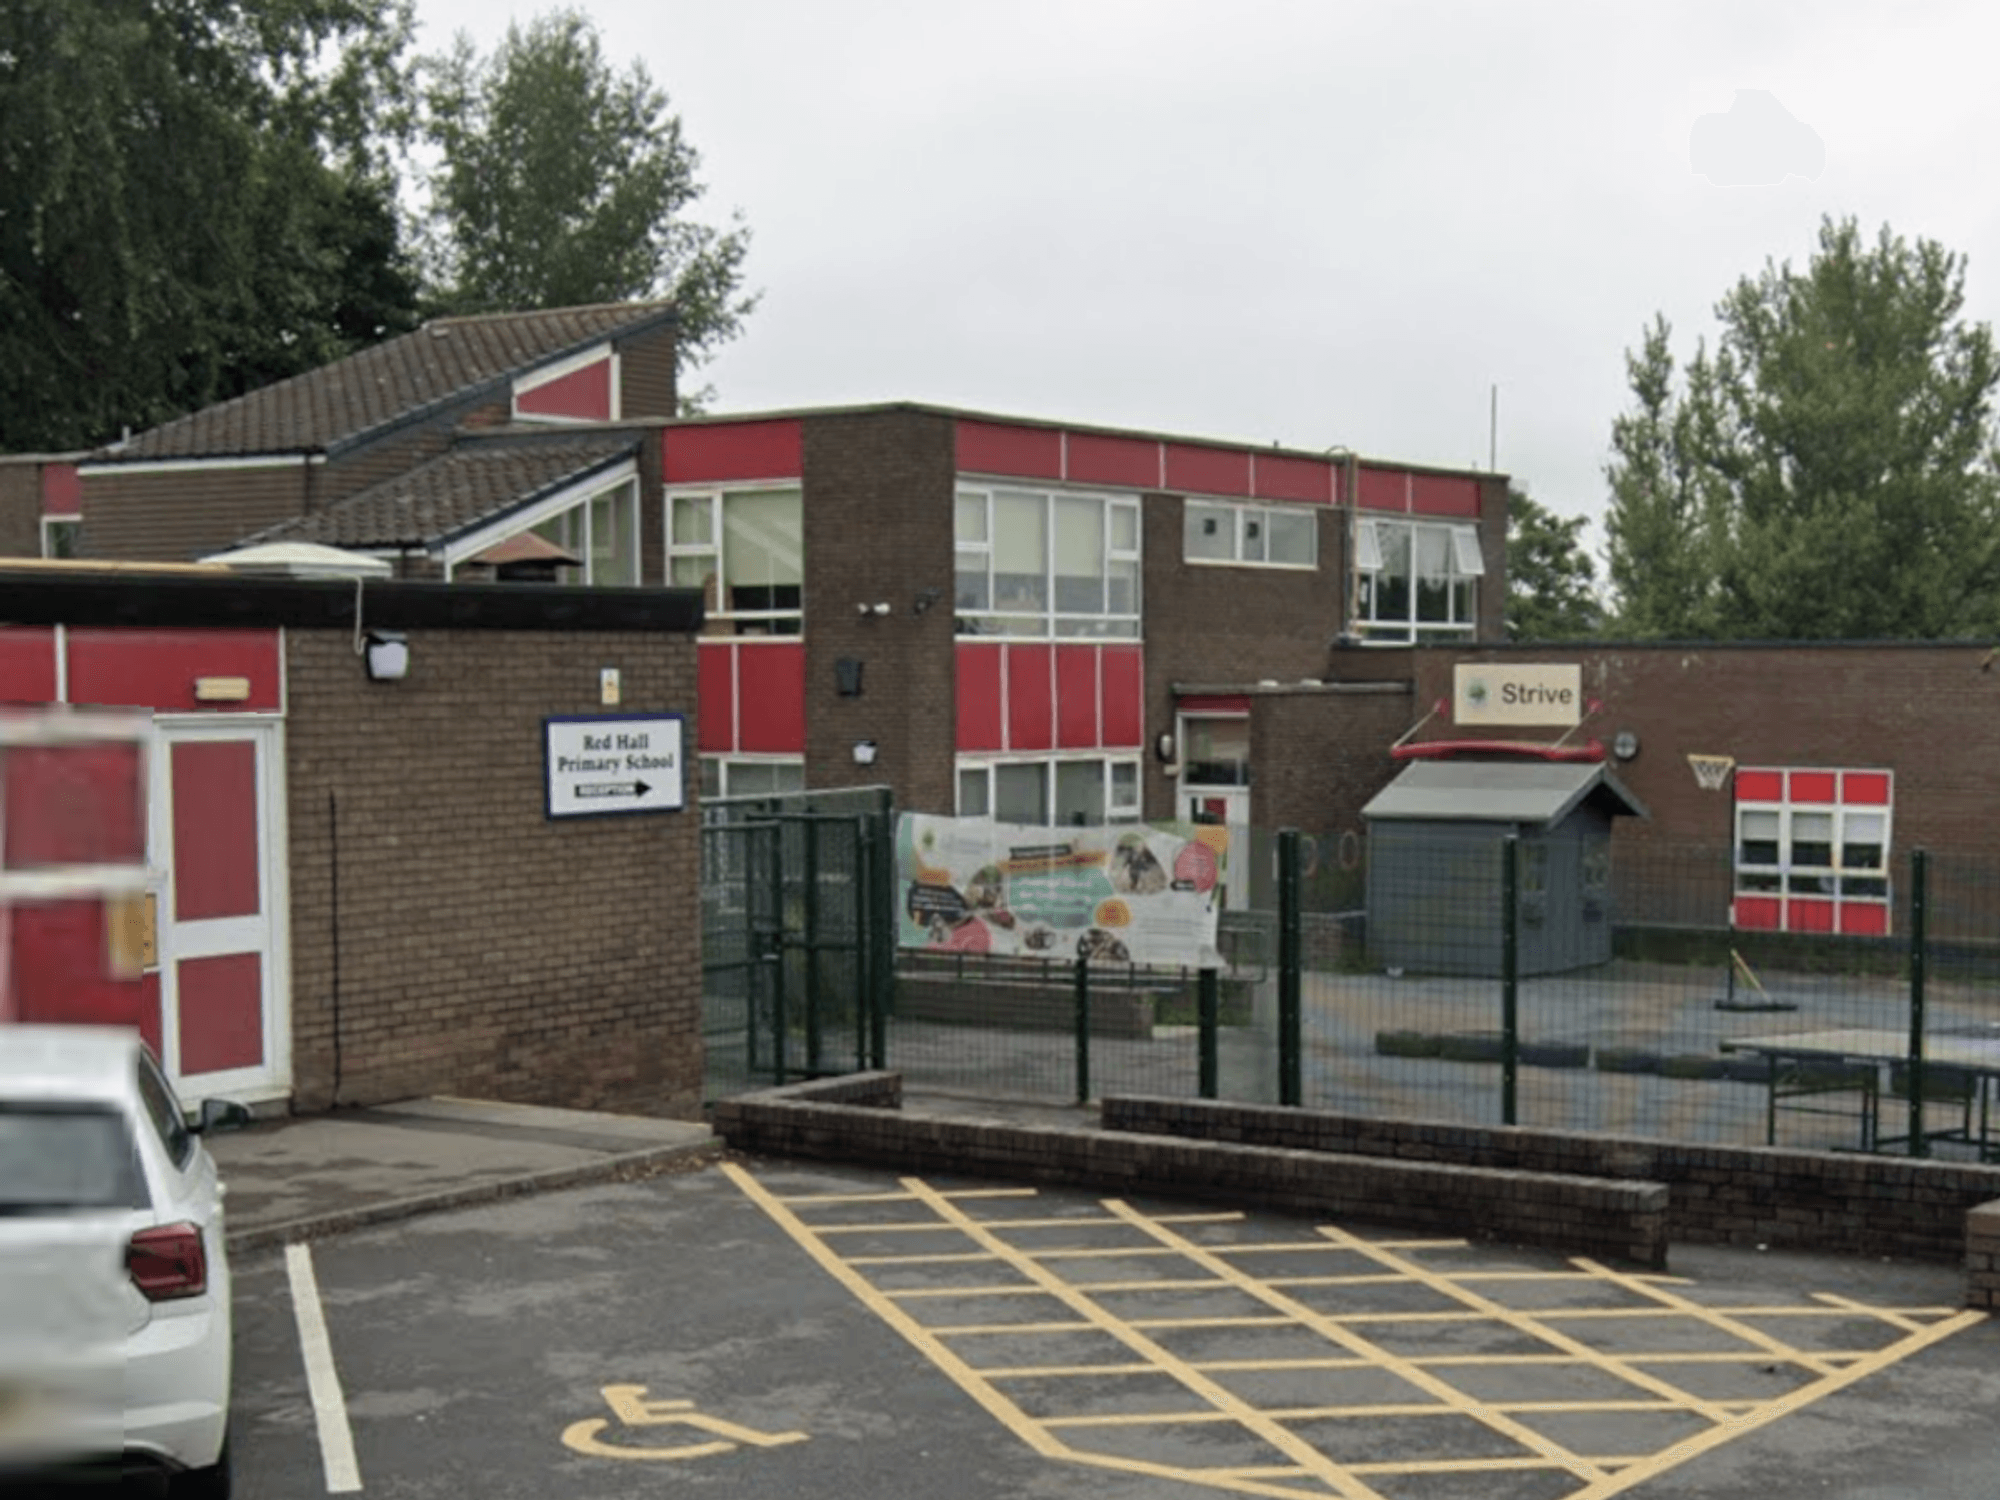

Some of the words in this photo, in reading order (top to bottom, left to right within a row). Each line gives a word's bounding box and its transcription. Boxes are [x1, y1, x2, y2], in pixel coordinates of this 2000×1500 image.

[1501, 682, 1572, 704] Strive
[584, 734, 612, 750] Red
[617, 733, 649, 749] Hall
[558, 754, 619, 774] Primary
[626, 752, 674, 770] School
